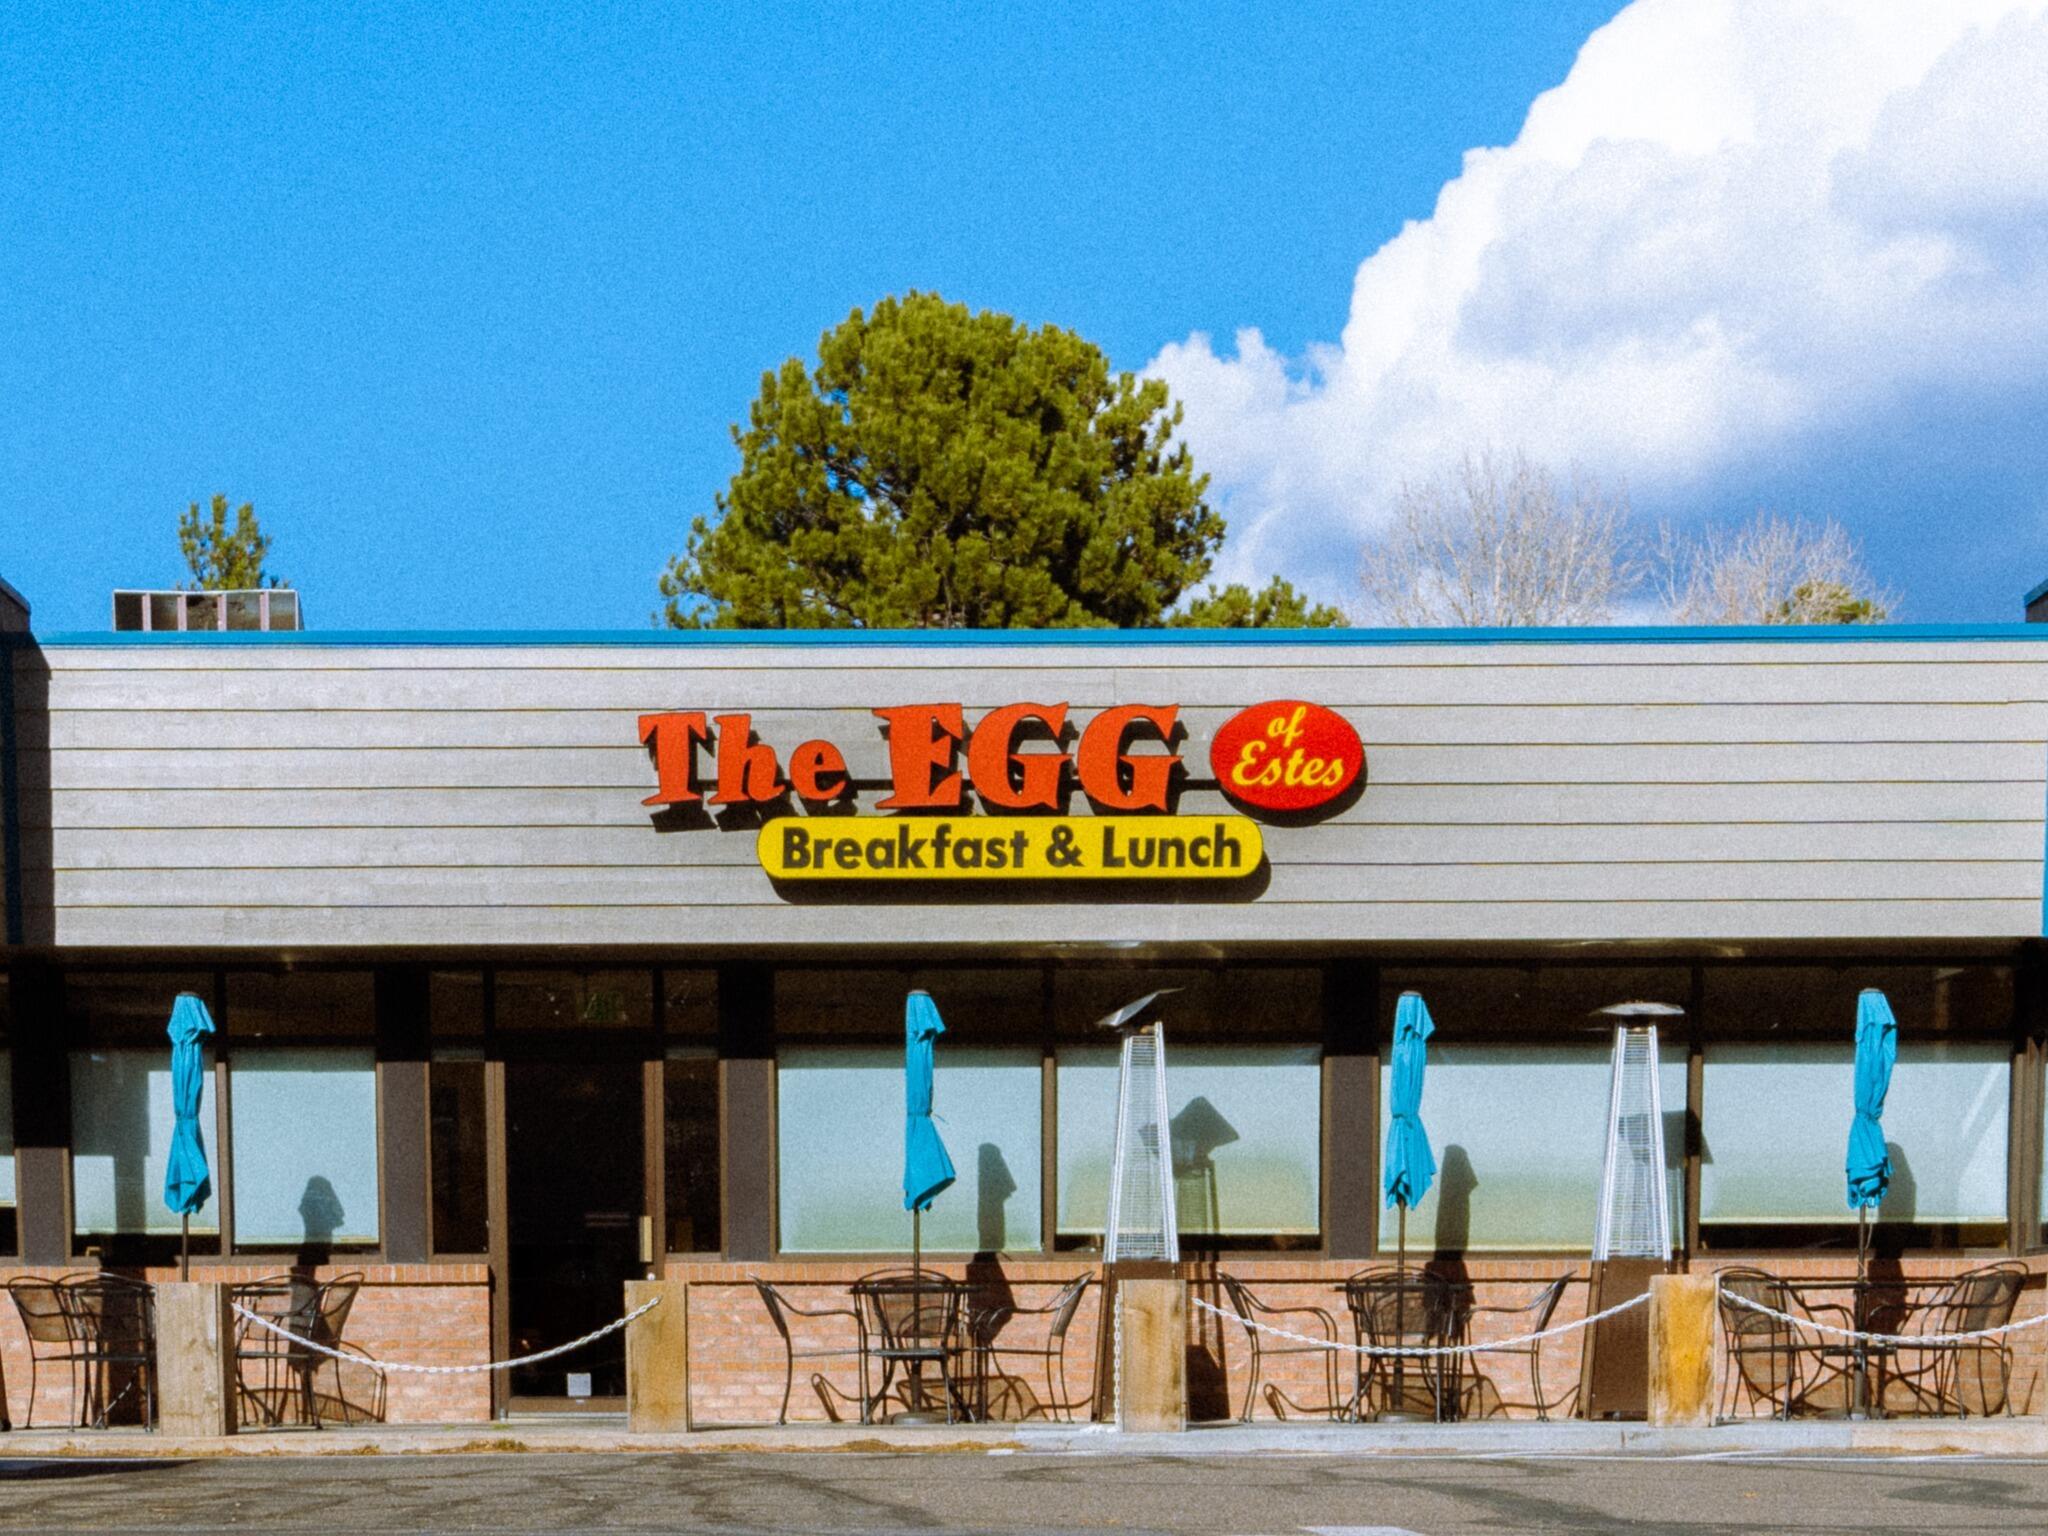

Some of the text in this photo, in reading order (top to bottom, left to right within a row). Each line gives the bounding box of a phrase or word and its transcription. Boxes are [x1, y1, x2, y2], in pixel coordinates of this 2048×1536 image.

[1267, 704, 1307, 748] of
[638, 702, 1184, 810] The EGG
[1231, 739, 1345, 788] Estes
[782, 823, 1242, 869] Breakfast & Lunch
